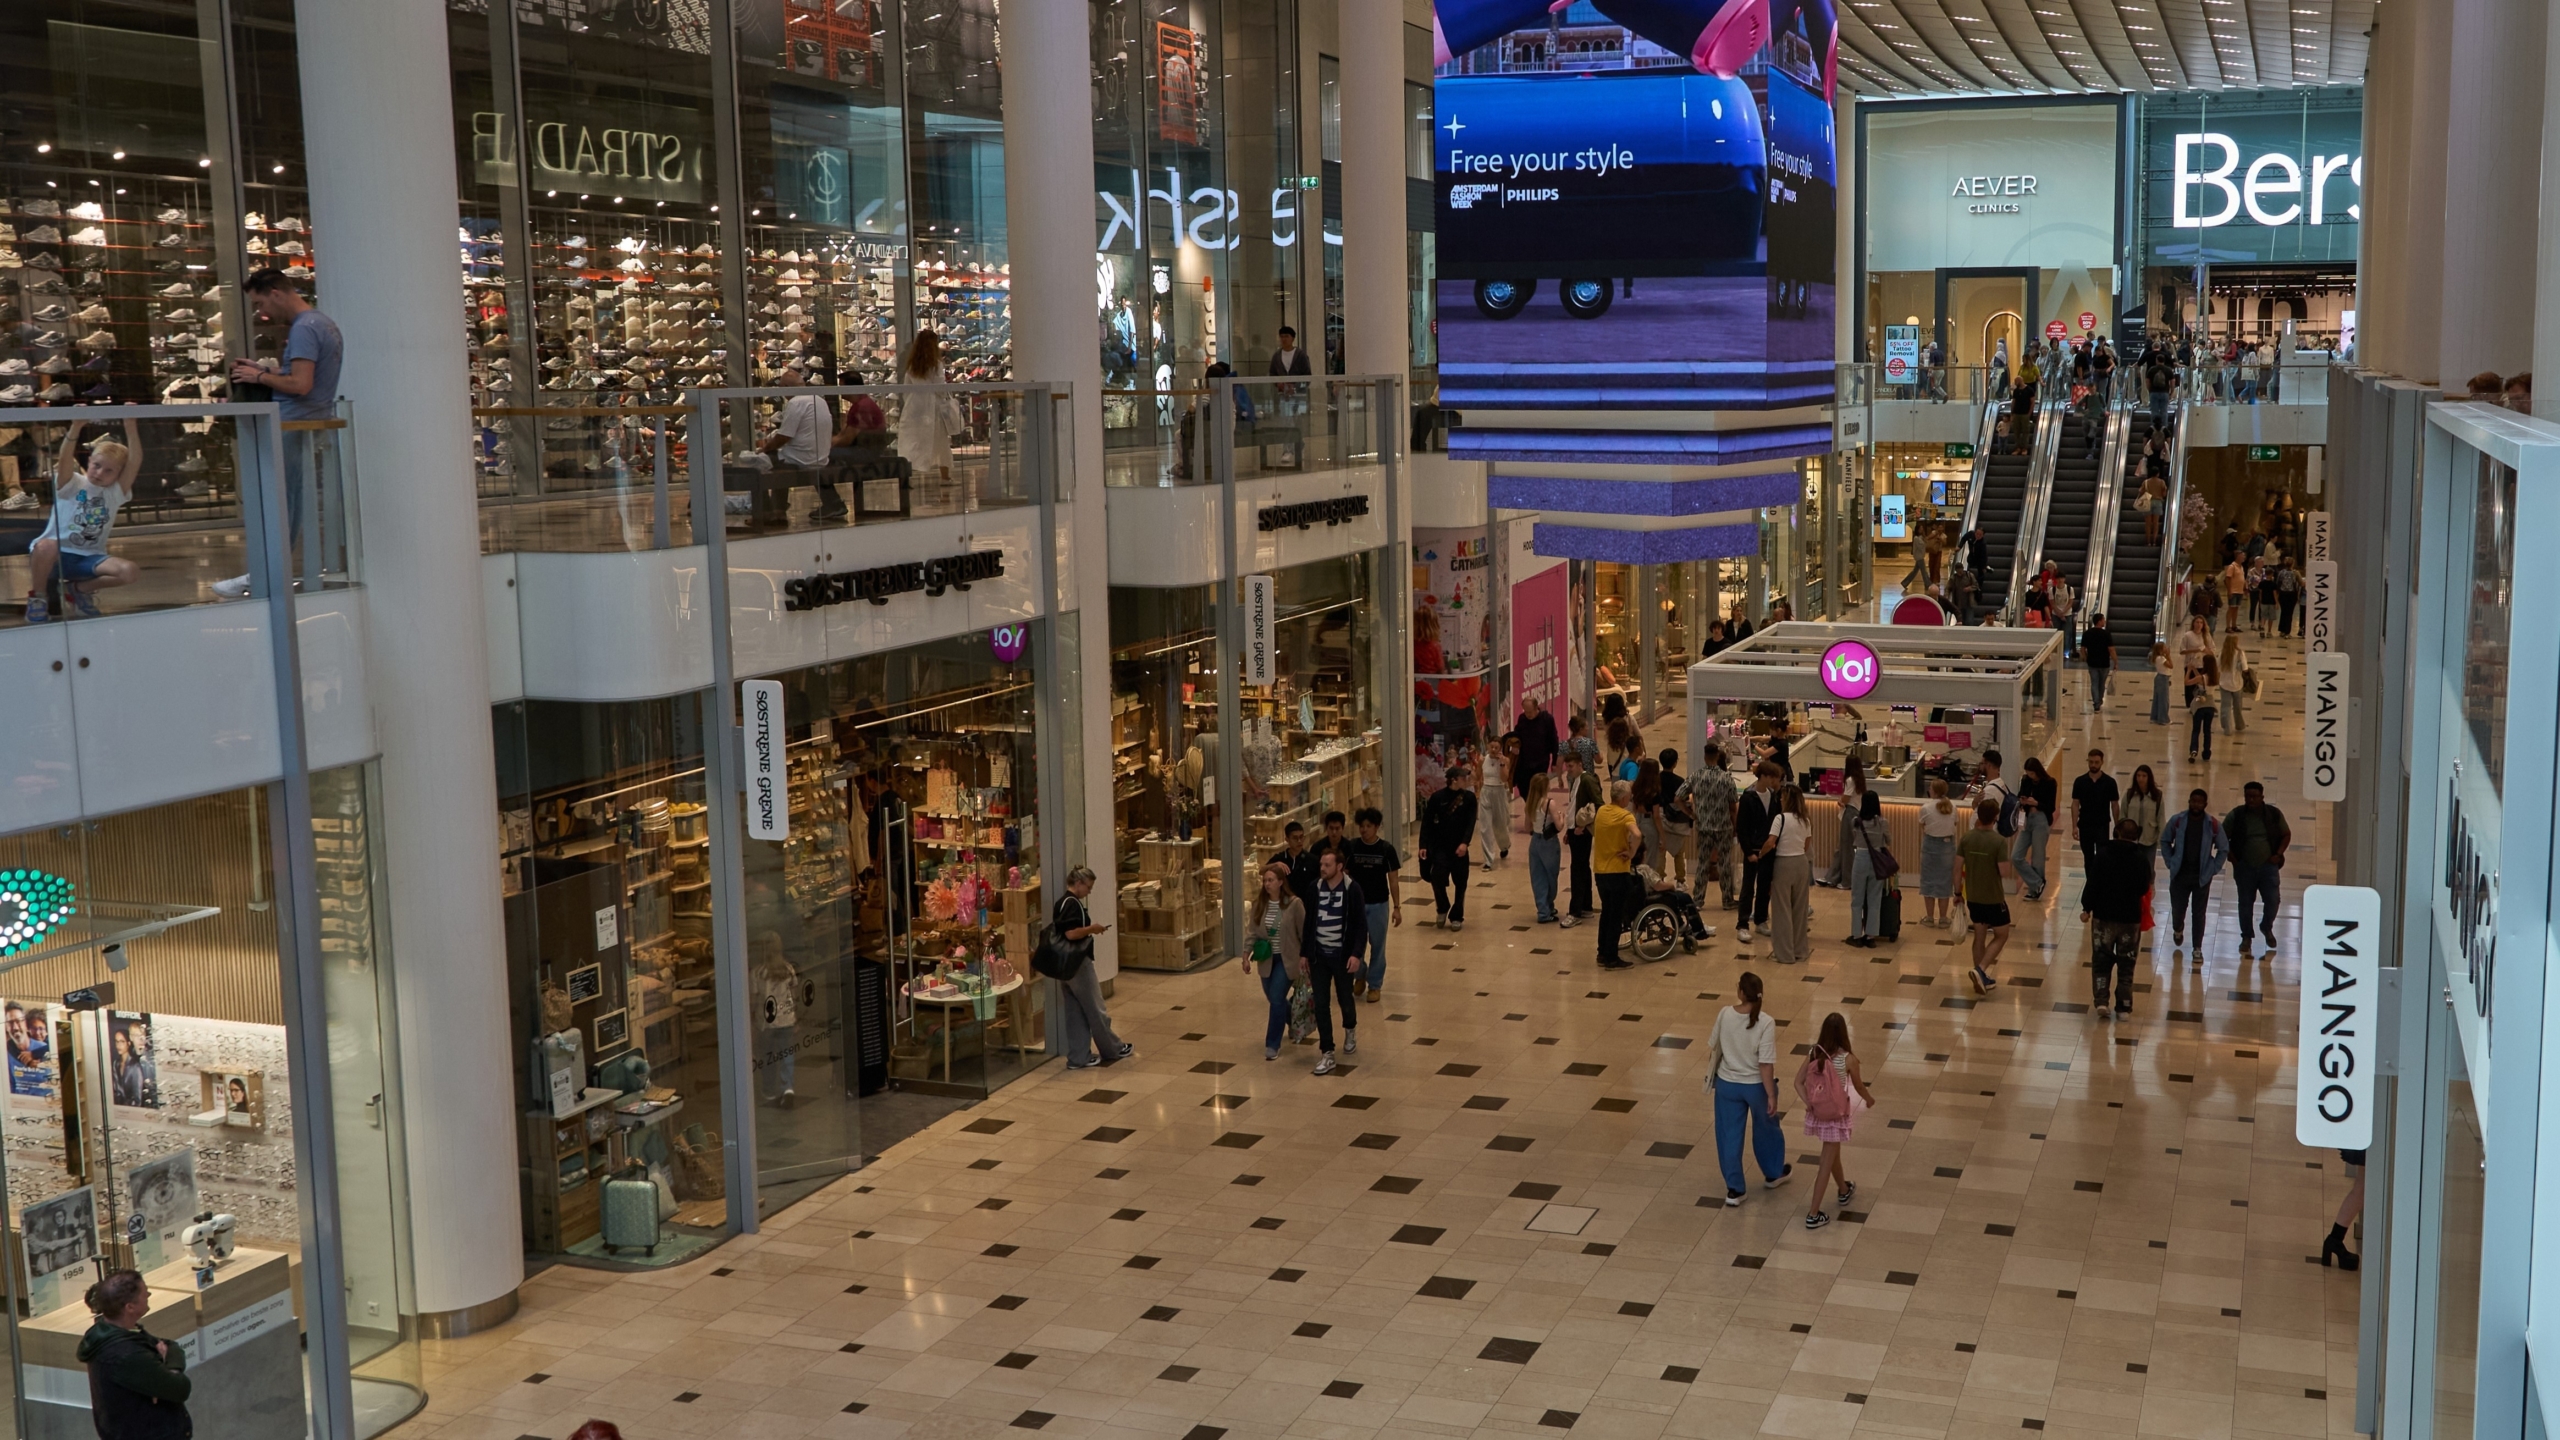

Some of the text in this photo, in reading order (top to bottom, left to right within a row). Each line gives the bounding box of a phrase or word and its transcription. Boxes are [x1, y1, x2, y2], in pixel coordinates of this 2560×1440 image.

[1450, 143, 1634, 179] Free your style
[1771, 142, 1784, 169] Free
[1785, 153, 1799, 178] your
[1800, 154, 1812, 184] style
[1451, 184, 1498, 193] AMSTERDAM
[1451, 192, 1482, 201] FASHION
[1507, 188, 1560, 201] PHILIPS
[1952, 174, 2038, 197] AEVER
[2173, 133, 2361, 228] Ber
[1451, 200, 1473, 209] WEEK
[1967, 203, 2020, 213] CLINICS
[1258, 495, 1369, 531] SØSTRENE GRENE
[2314, 520, 2328, 561] MAN
[784, 550, 1005, 612] SØSTRENE GRENE
[1254, 582, 1265, 679] SØSTRENE GRENE
[1824, 655, 1873, 683] YO!
[2314, 670, 2338, 787] MANGO
[756, 690, 773, 831] SØSTRENE GRENE
[2317, 919, 2359, 1123] MANGO
[766, 1043, 800, 1066] Zussen
[802, 1028, 833, 1049] Grene
[62, 1266, 84, 1281] 1959
